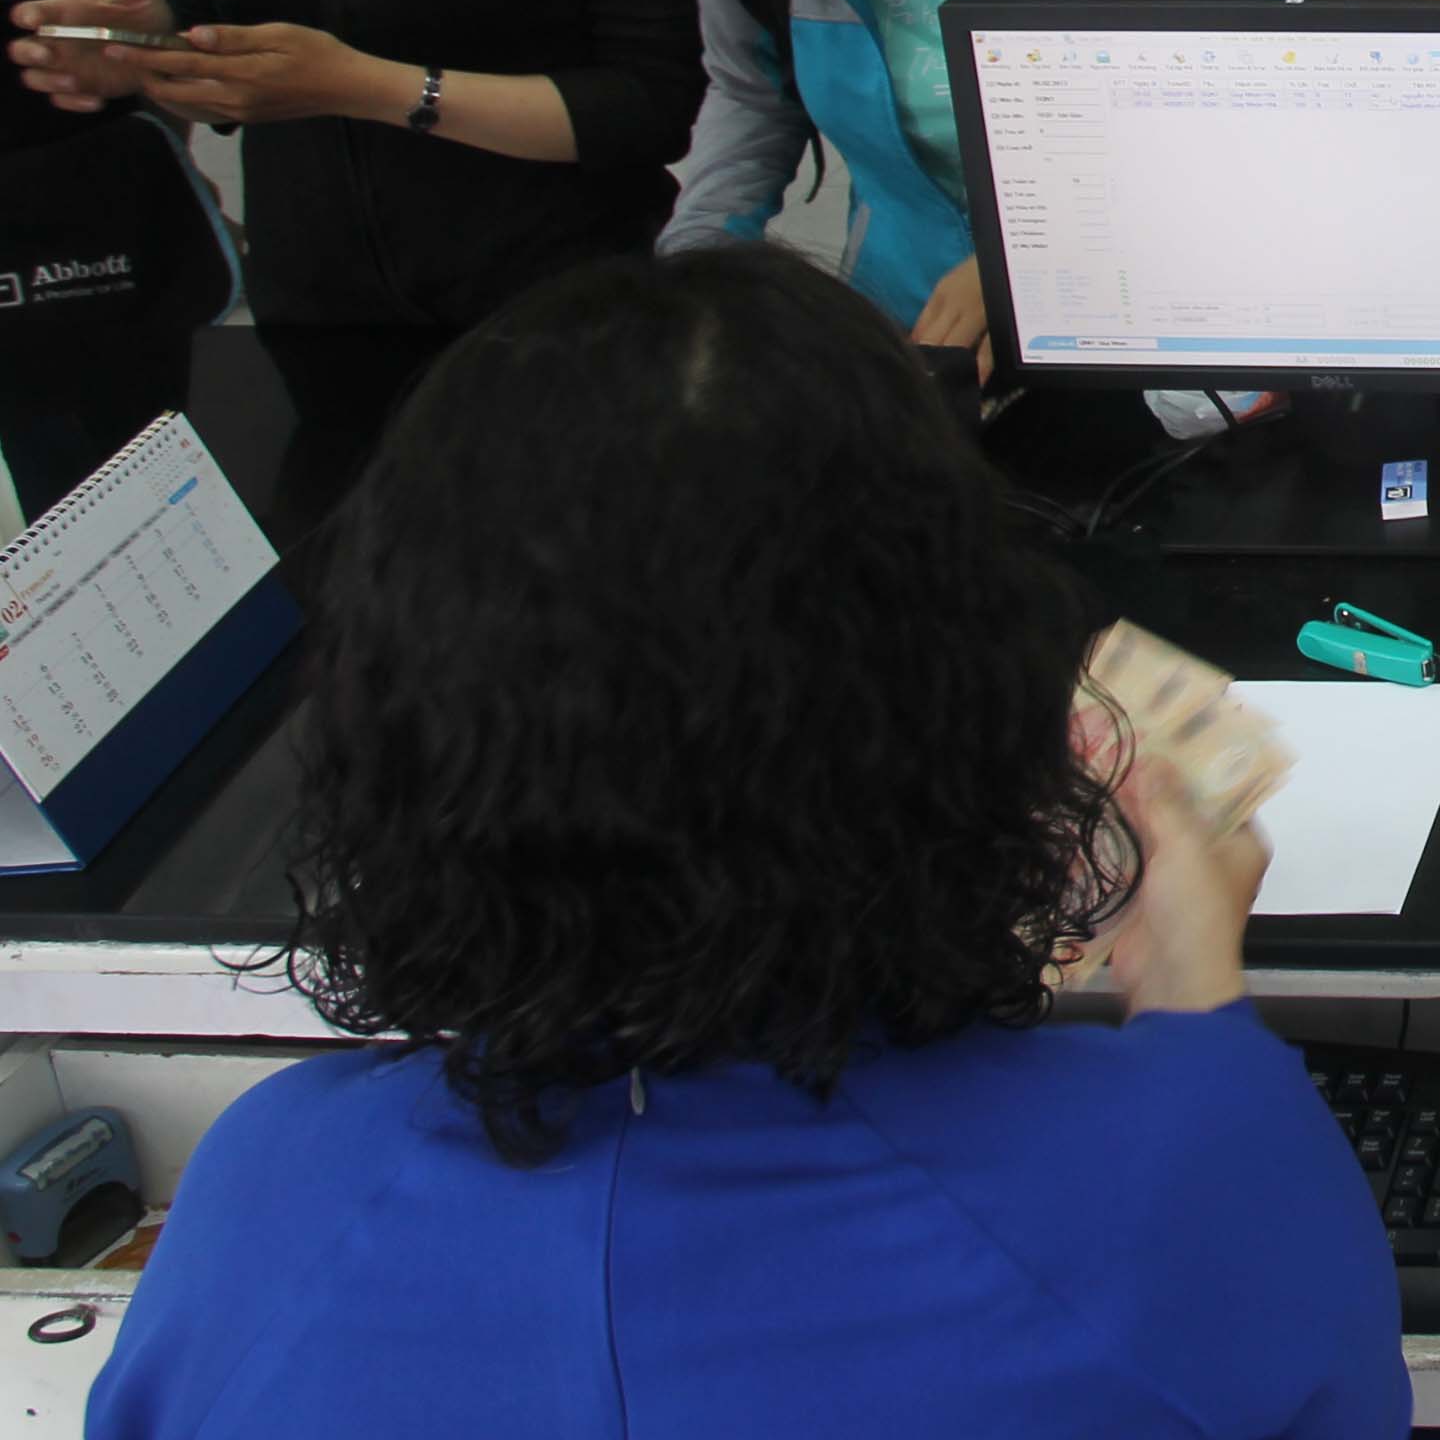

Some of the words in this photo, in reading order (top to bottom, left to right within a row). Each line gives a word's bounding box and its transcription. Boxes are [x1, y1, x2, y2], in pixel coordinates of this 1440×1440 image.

[32, 253, 132, 286] Abbott
[1311, 375, 1355, 389] DELL
[1, 599, 24, 625] 02
